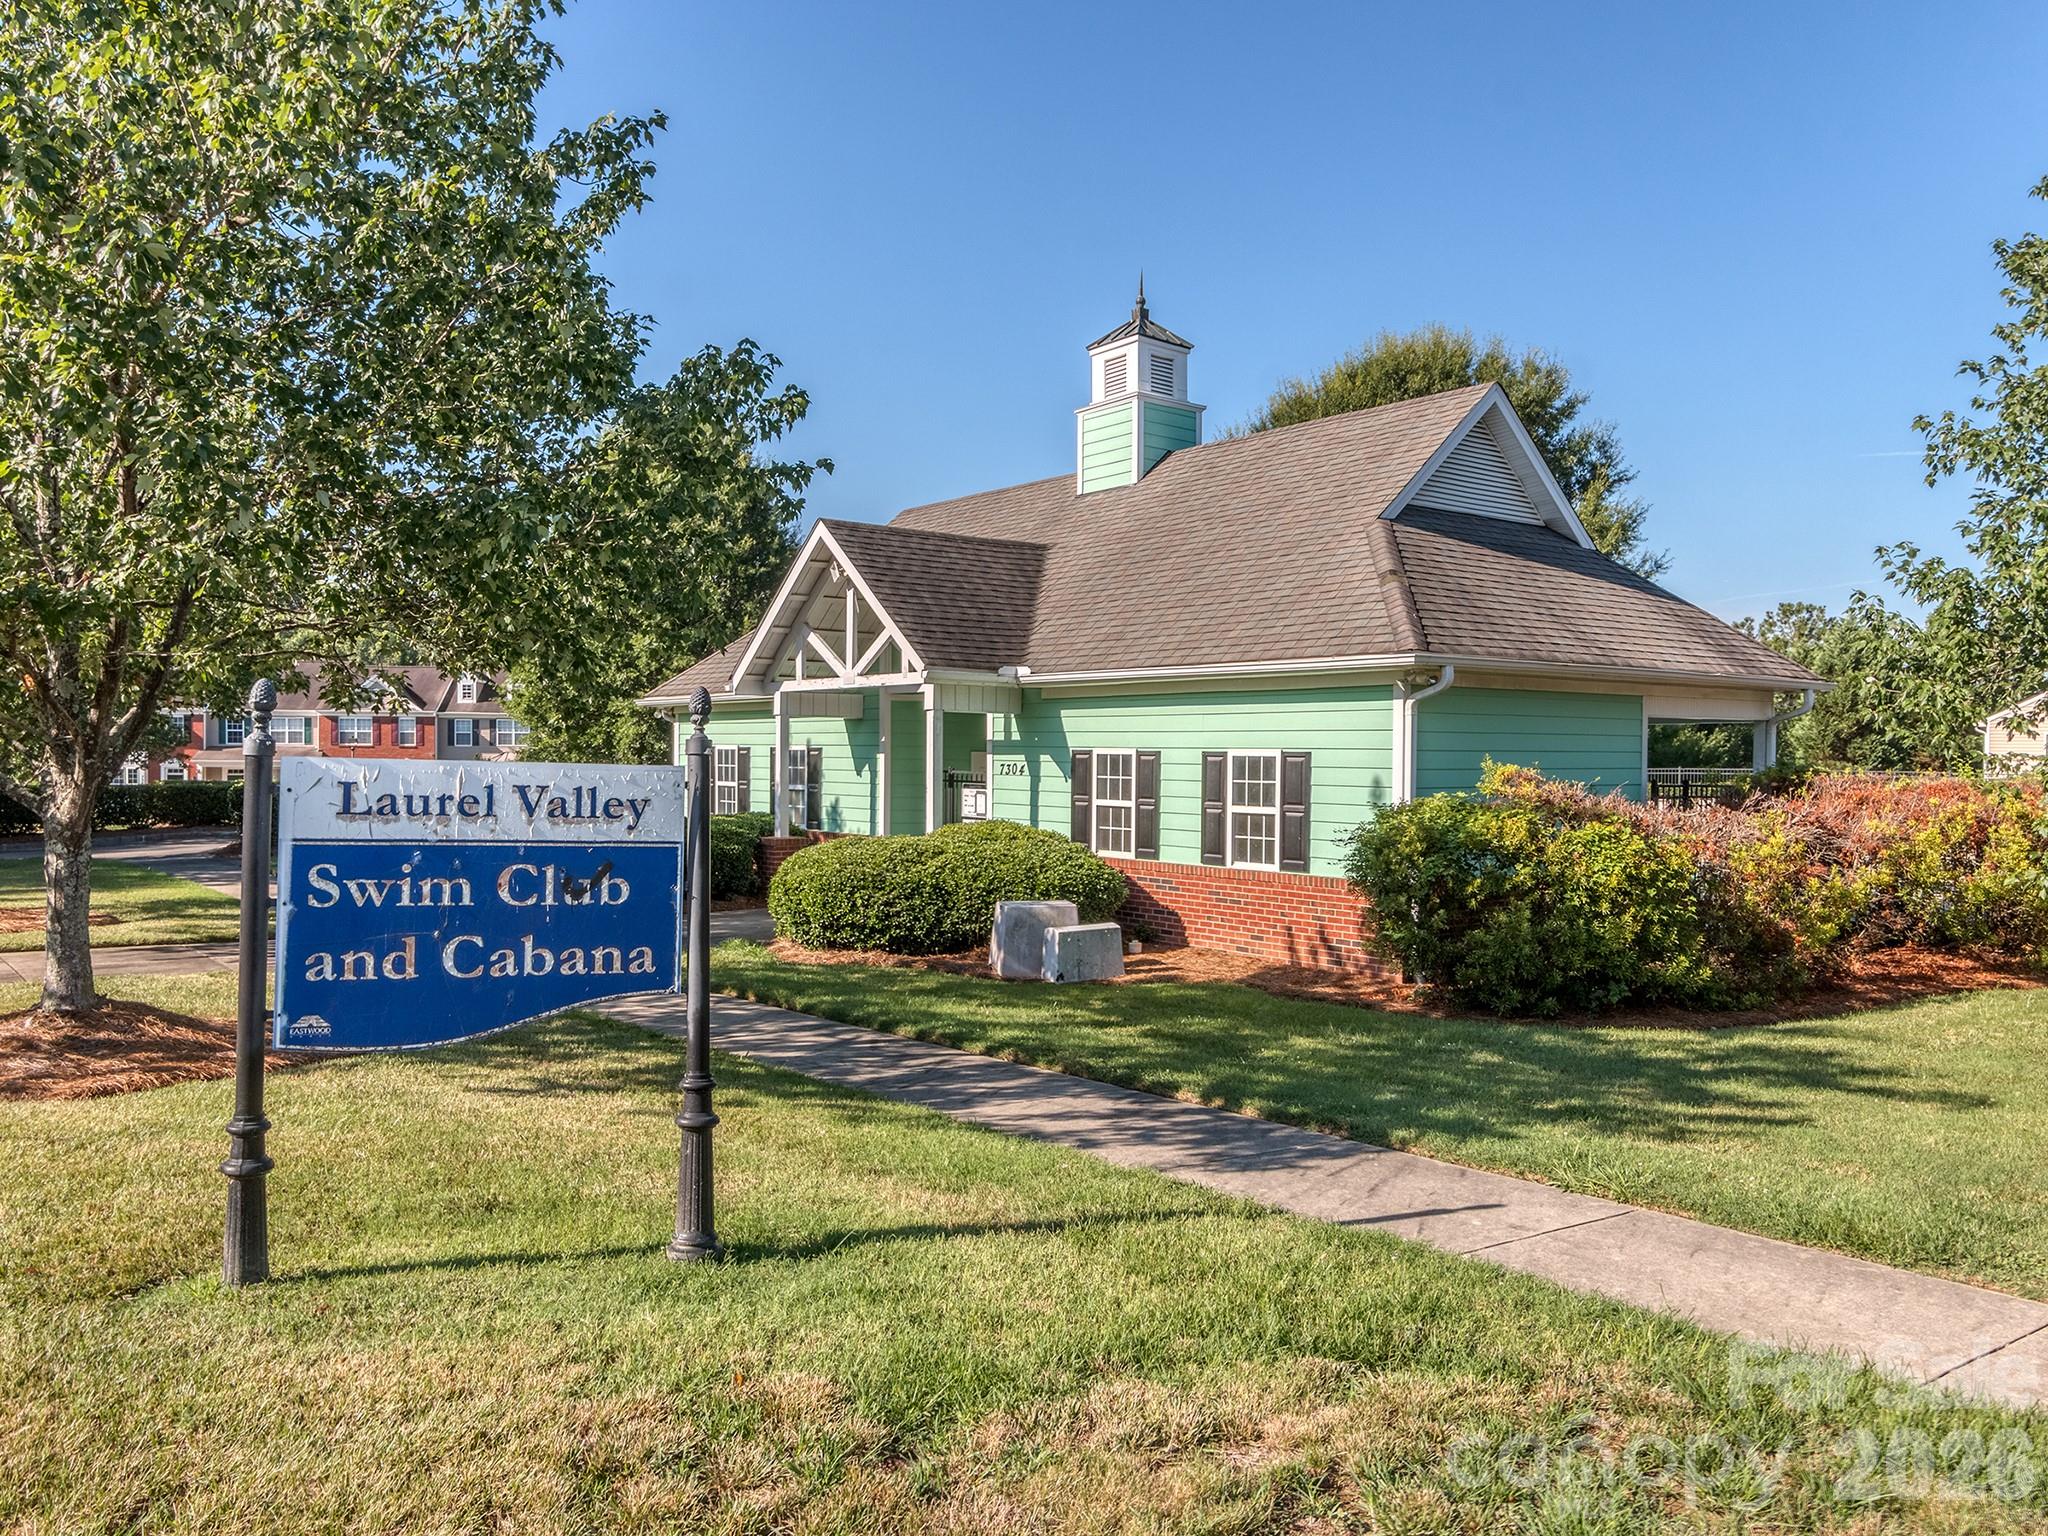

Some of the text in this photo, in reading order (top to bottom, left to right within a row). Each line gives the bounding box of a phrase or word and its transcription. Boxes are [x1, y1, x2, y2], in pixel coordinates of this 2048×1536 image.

[999, 763, 1026, 776] 7304
[336, 780, 652, 831] Laurel Valley
[307, 862, 631, 908] Swim Club
[304, 934, 656, 982] and Cabana
[289, 1027, 332, 1035] EASTWOOD
